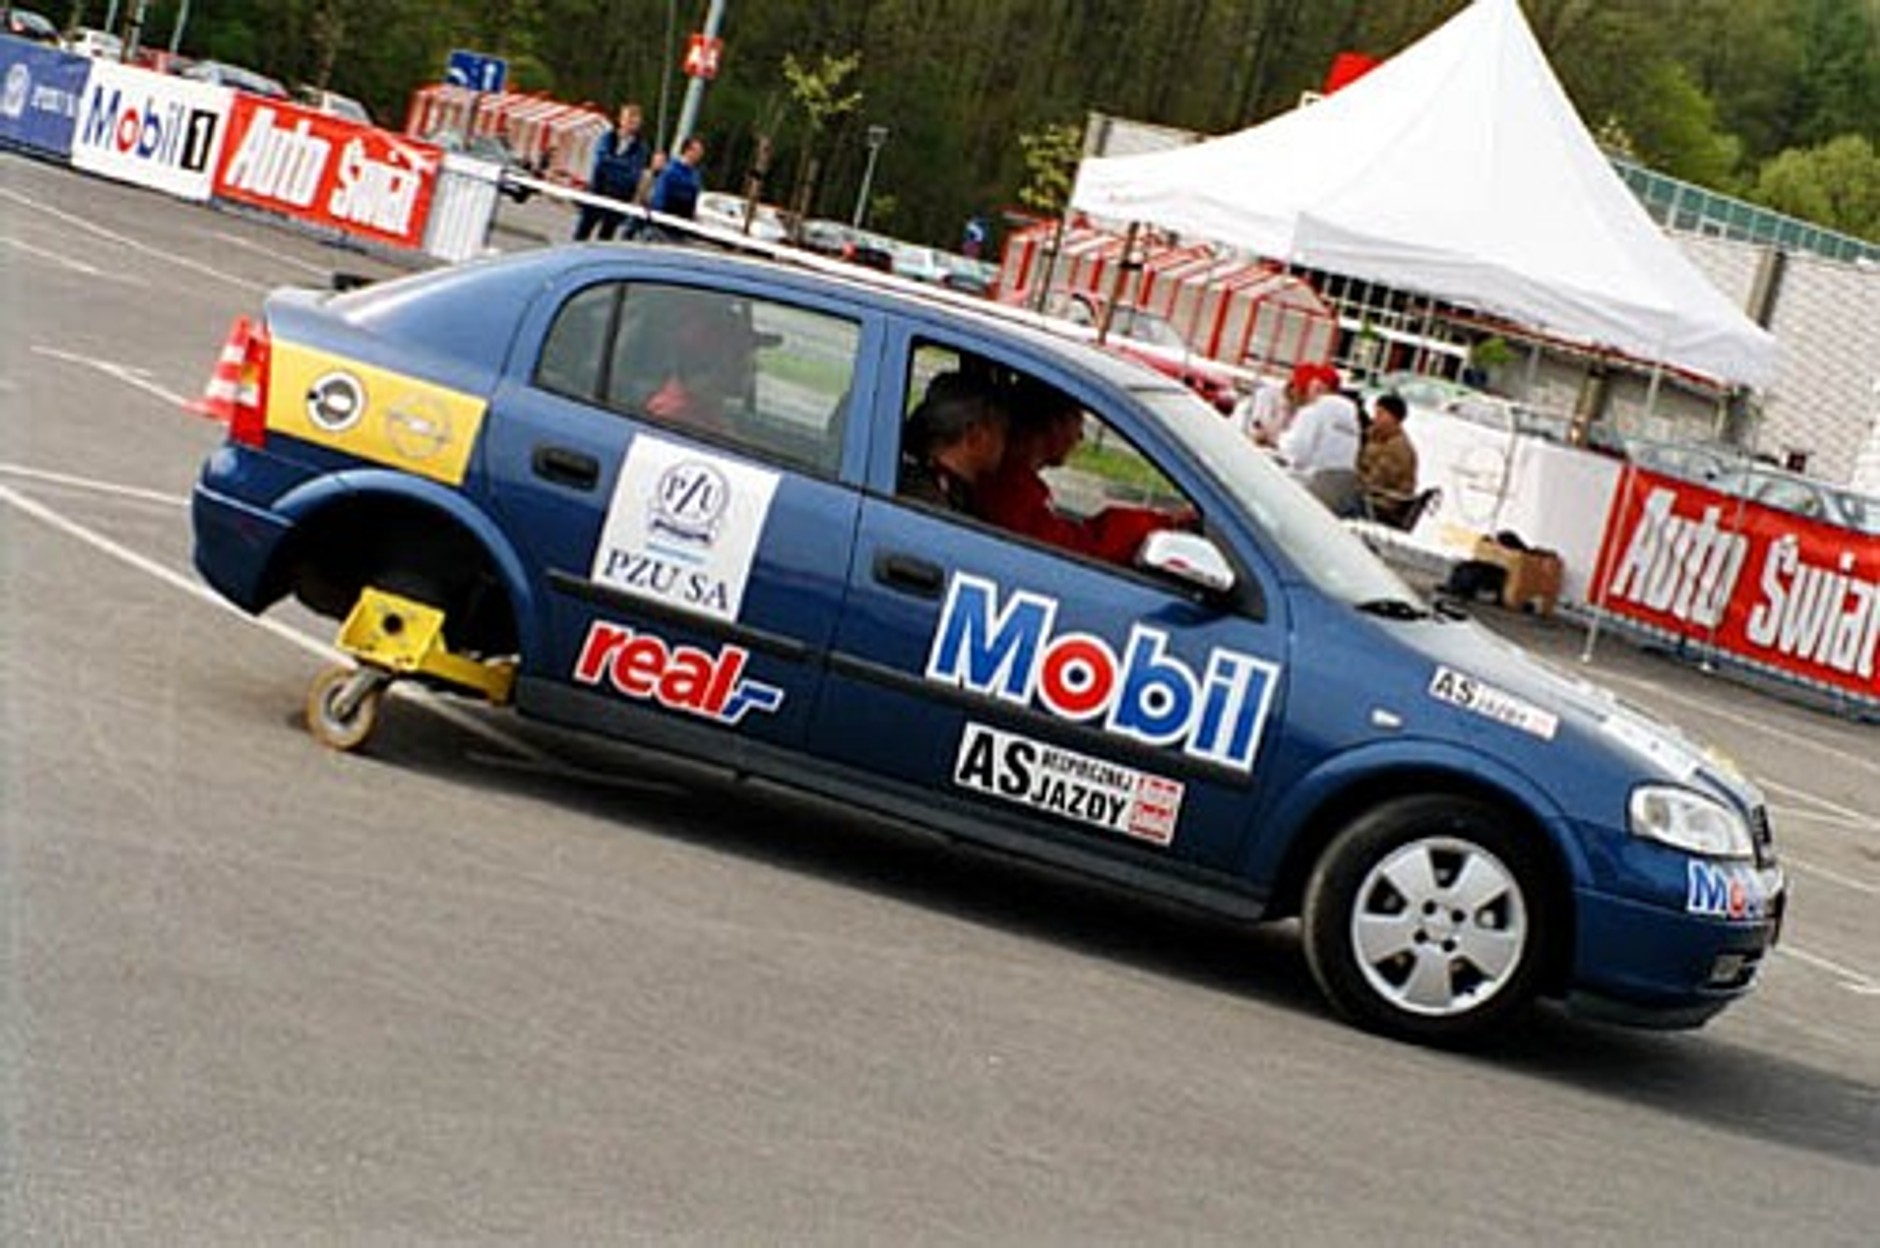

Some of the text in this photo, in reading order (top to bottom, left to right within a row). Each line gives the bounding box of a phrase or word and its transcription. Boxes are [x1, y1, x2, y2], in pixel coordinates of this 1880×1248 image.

[82, 85, 184, 168] Mobil
[183, 109, 215, 170] 1
[225, 107, 332, 207] Auto
[603, 548, 680, 594] PZU
[684, 573, 728, 611] SA
[1611, 487, 1748, 629] Auto
[929, 574, 1278, 770] Mobil
[958, 732, 1036, 798] AS
